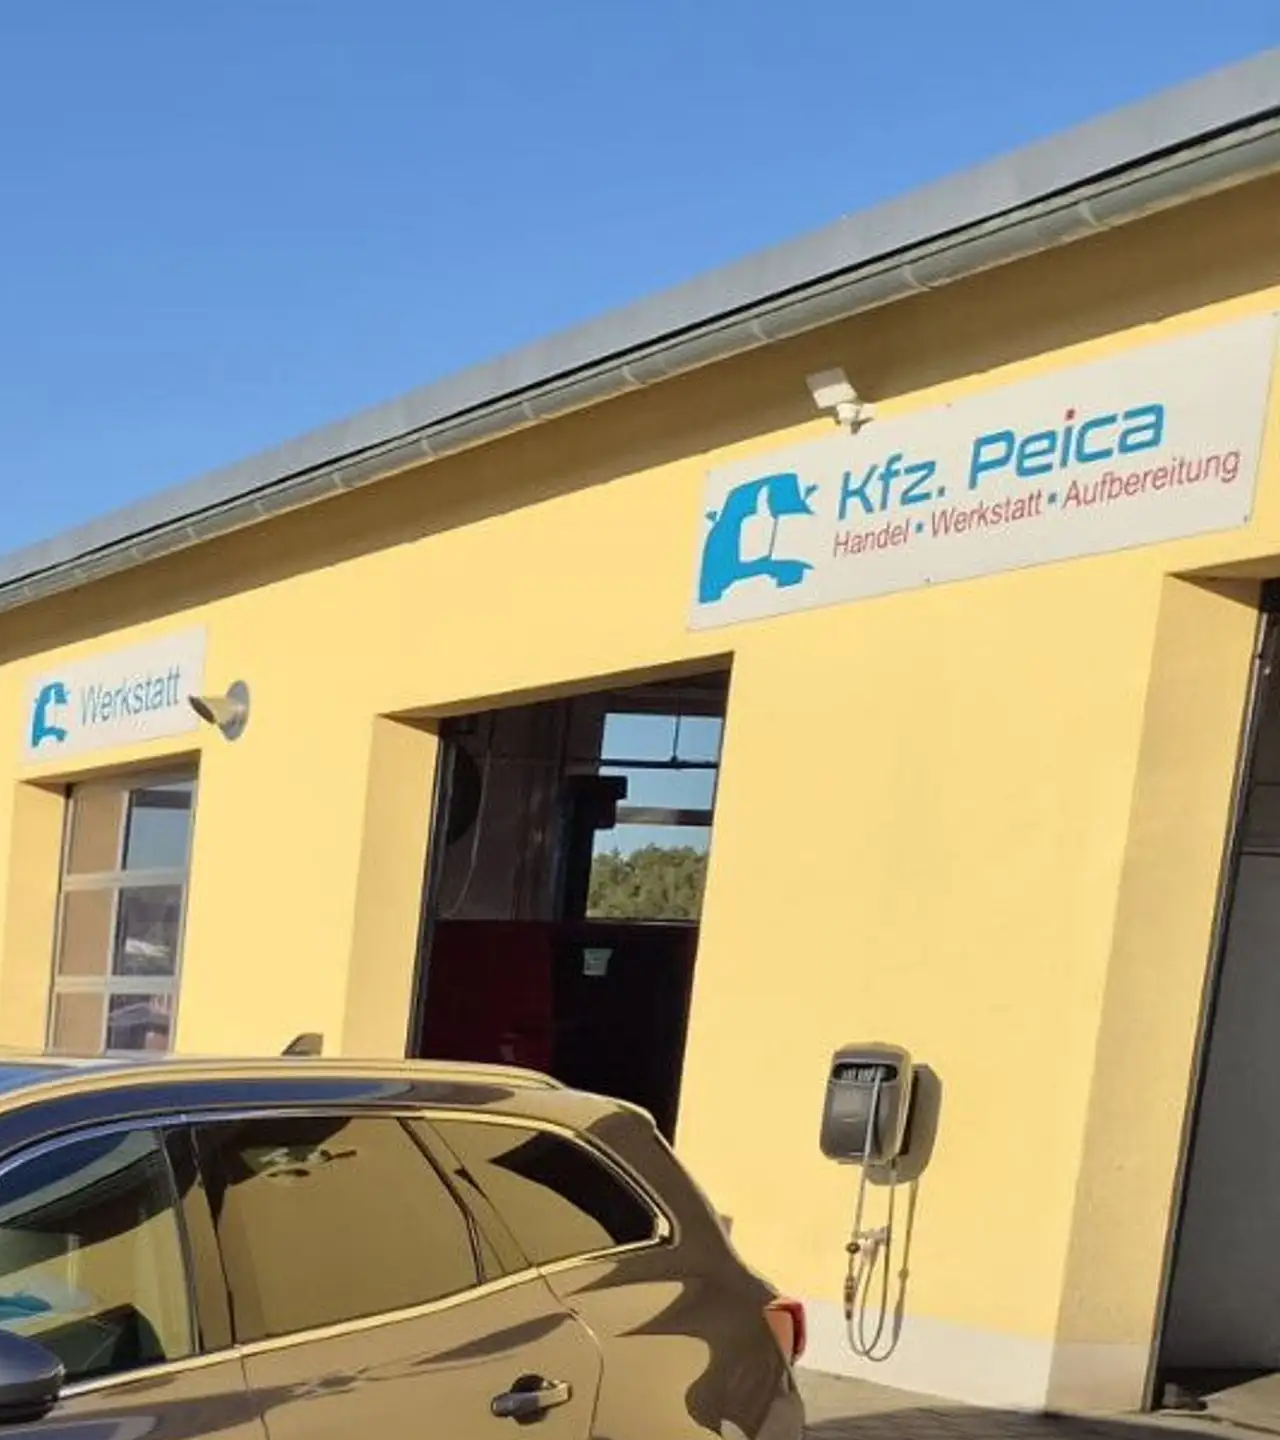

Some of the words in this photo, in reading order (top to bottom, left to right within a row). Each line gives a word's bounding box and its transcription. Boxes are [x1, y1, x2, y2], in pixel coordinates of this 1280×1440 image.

[832, 517, 911, 558] Handel
[930, 488, 1043, 539] Werkstatt
[1060, 448, 1241, 510] Aufbereitung
[837, 452, 946, 521] Kfz.
[968, 402, 1165, 490] Peica
[81, 664, 180, 726] Werkstatt
